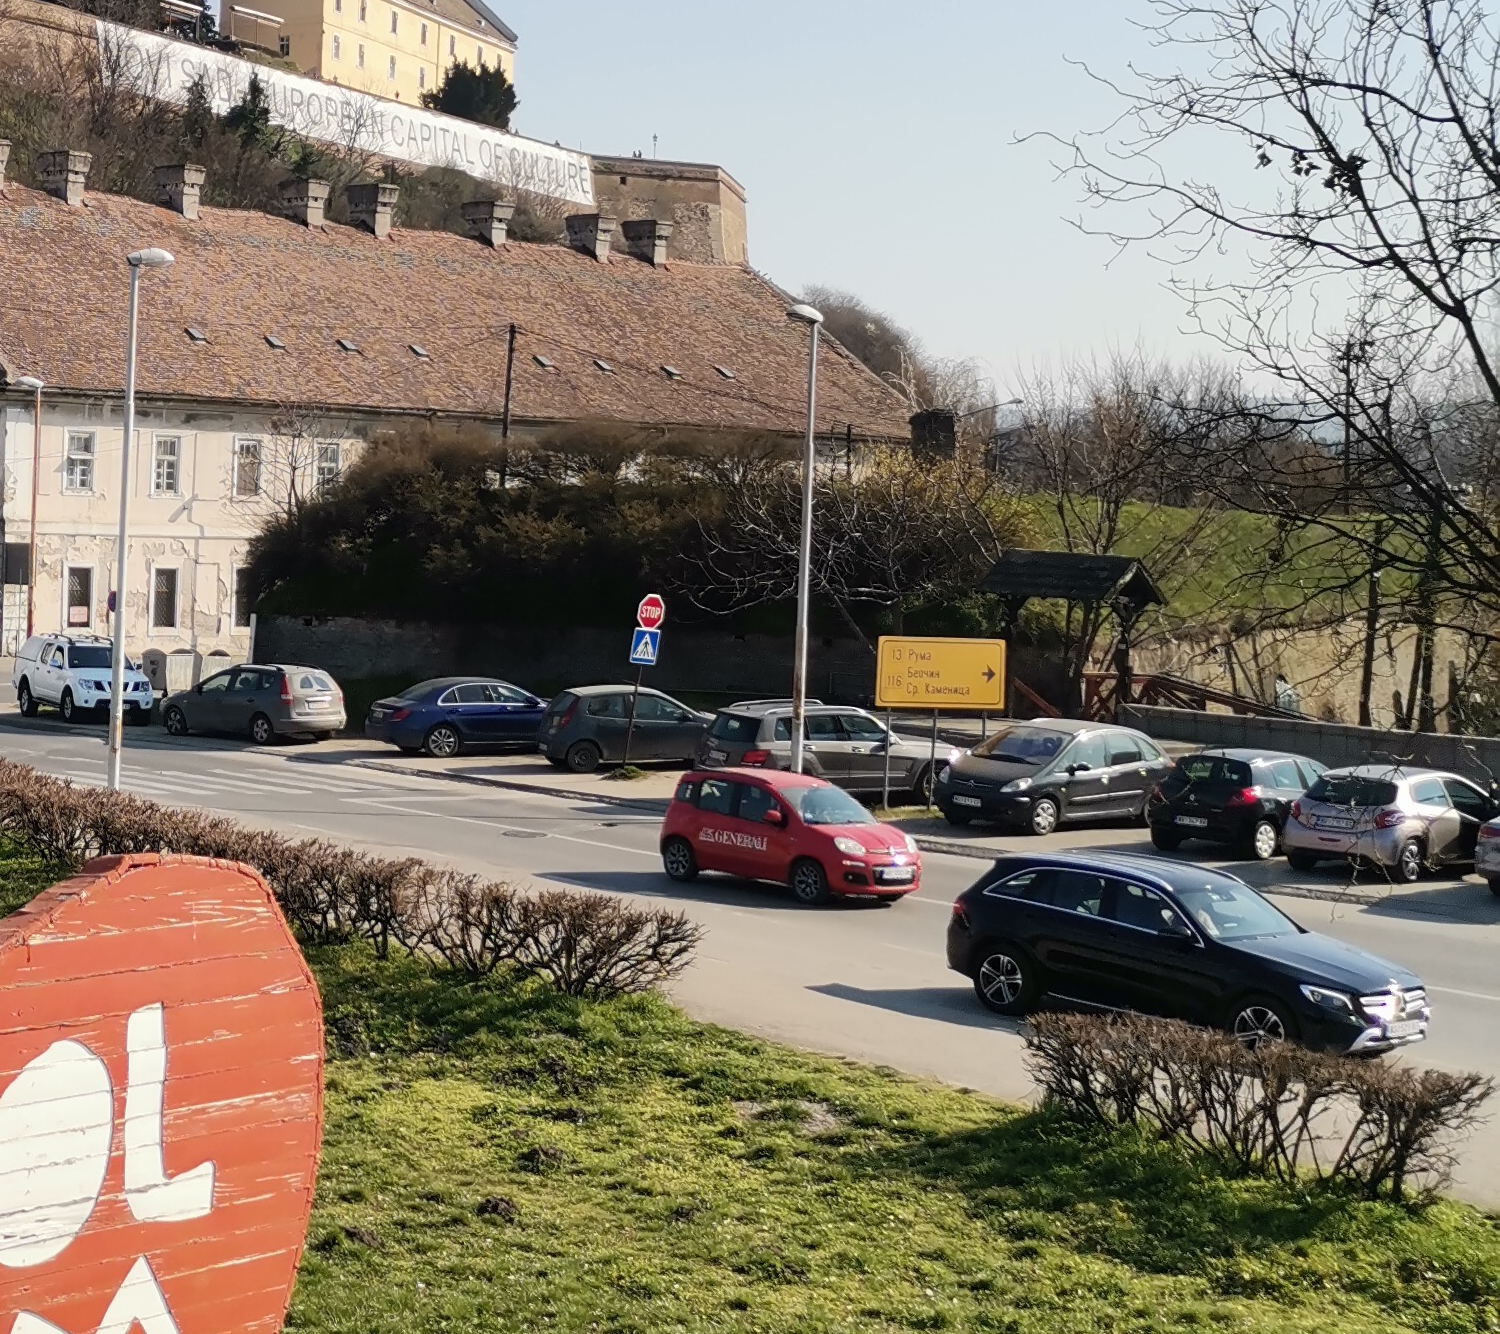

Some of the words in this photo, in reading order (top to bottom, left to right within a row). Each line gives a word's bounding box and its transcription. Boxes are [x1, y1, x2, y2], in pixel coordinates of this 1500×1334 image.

[390, 113, 475, 166] CAPITAL
[478, 138, 504, 175] OF
[508, 146, 591, 196] CULTURE
[641, 605, 661, 619] STOP
[892, 649, 903, 661] 13
[908, 648, 932, 662] Рума
[907, 667, 940, 679] Беочин
[887, 675, 902, 687] 116
[924, 682, 970, 696] Каменица
